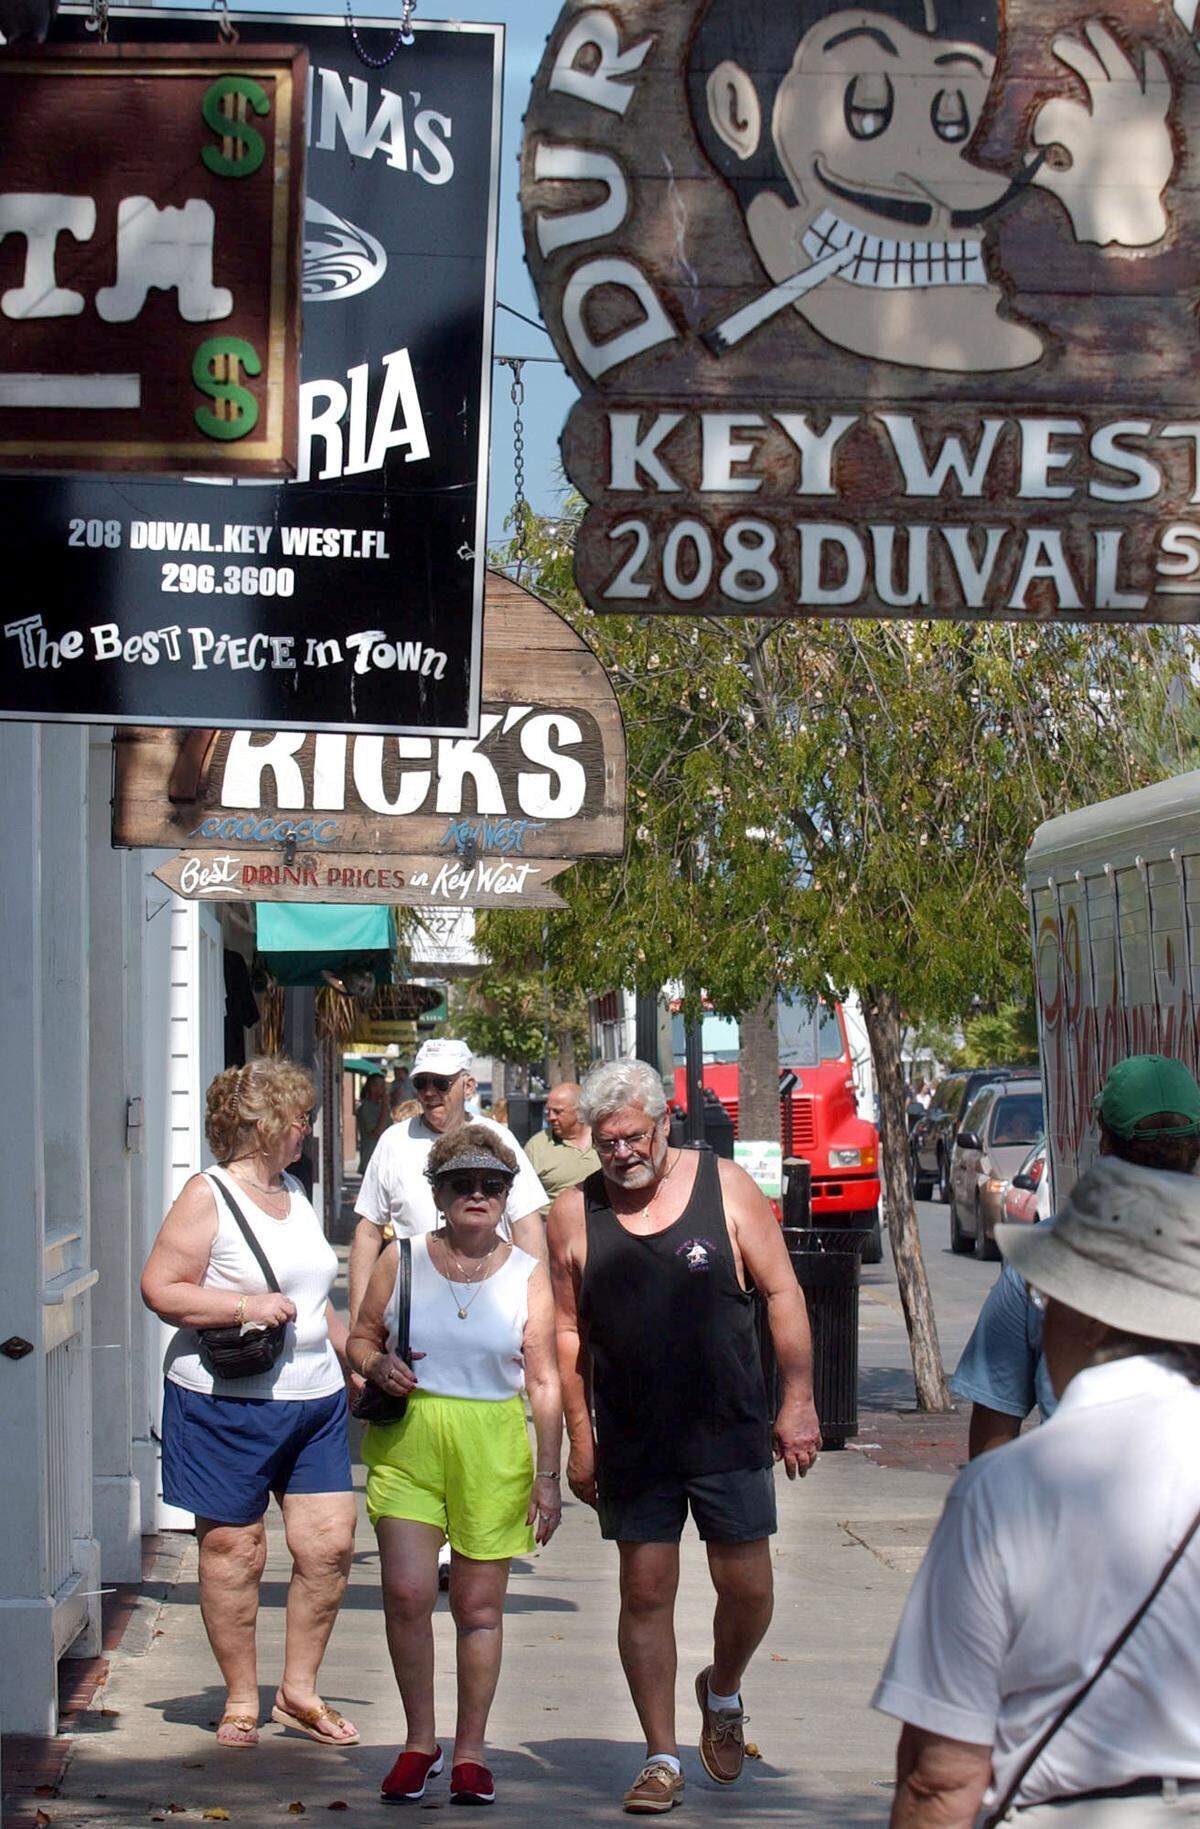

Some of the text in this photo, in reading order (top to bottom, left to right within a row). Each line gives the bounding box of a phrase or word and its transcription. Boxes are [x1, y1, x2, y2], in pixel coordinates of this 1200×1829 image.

[290, 348, 430, 482] RIA
[608, 412, 858, 497] KEY
[68, 518, 122, 548] 208
[281, 526, 390, 559] WEST.FL
[603, 519, 781, 601] 208
[799, 521, 1149, 610] DUVAL
[160, 562, 294, 598] 296.3600
[4, 614, 84, 669] The
[221, 706, 587, 819] RICK'S
[181, 855, 541, 899] Best DRINK PRICES in Key West
